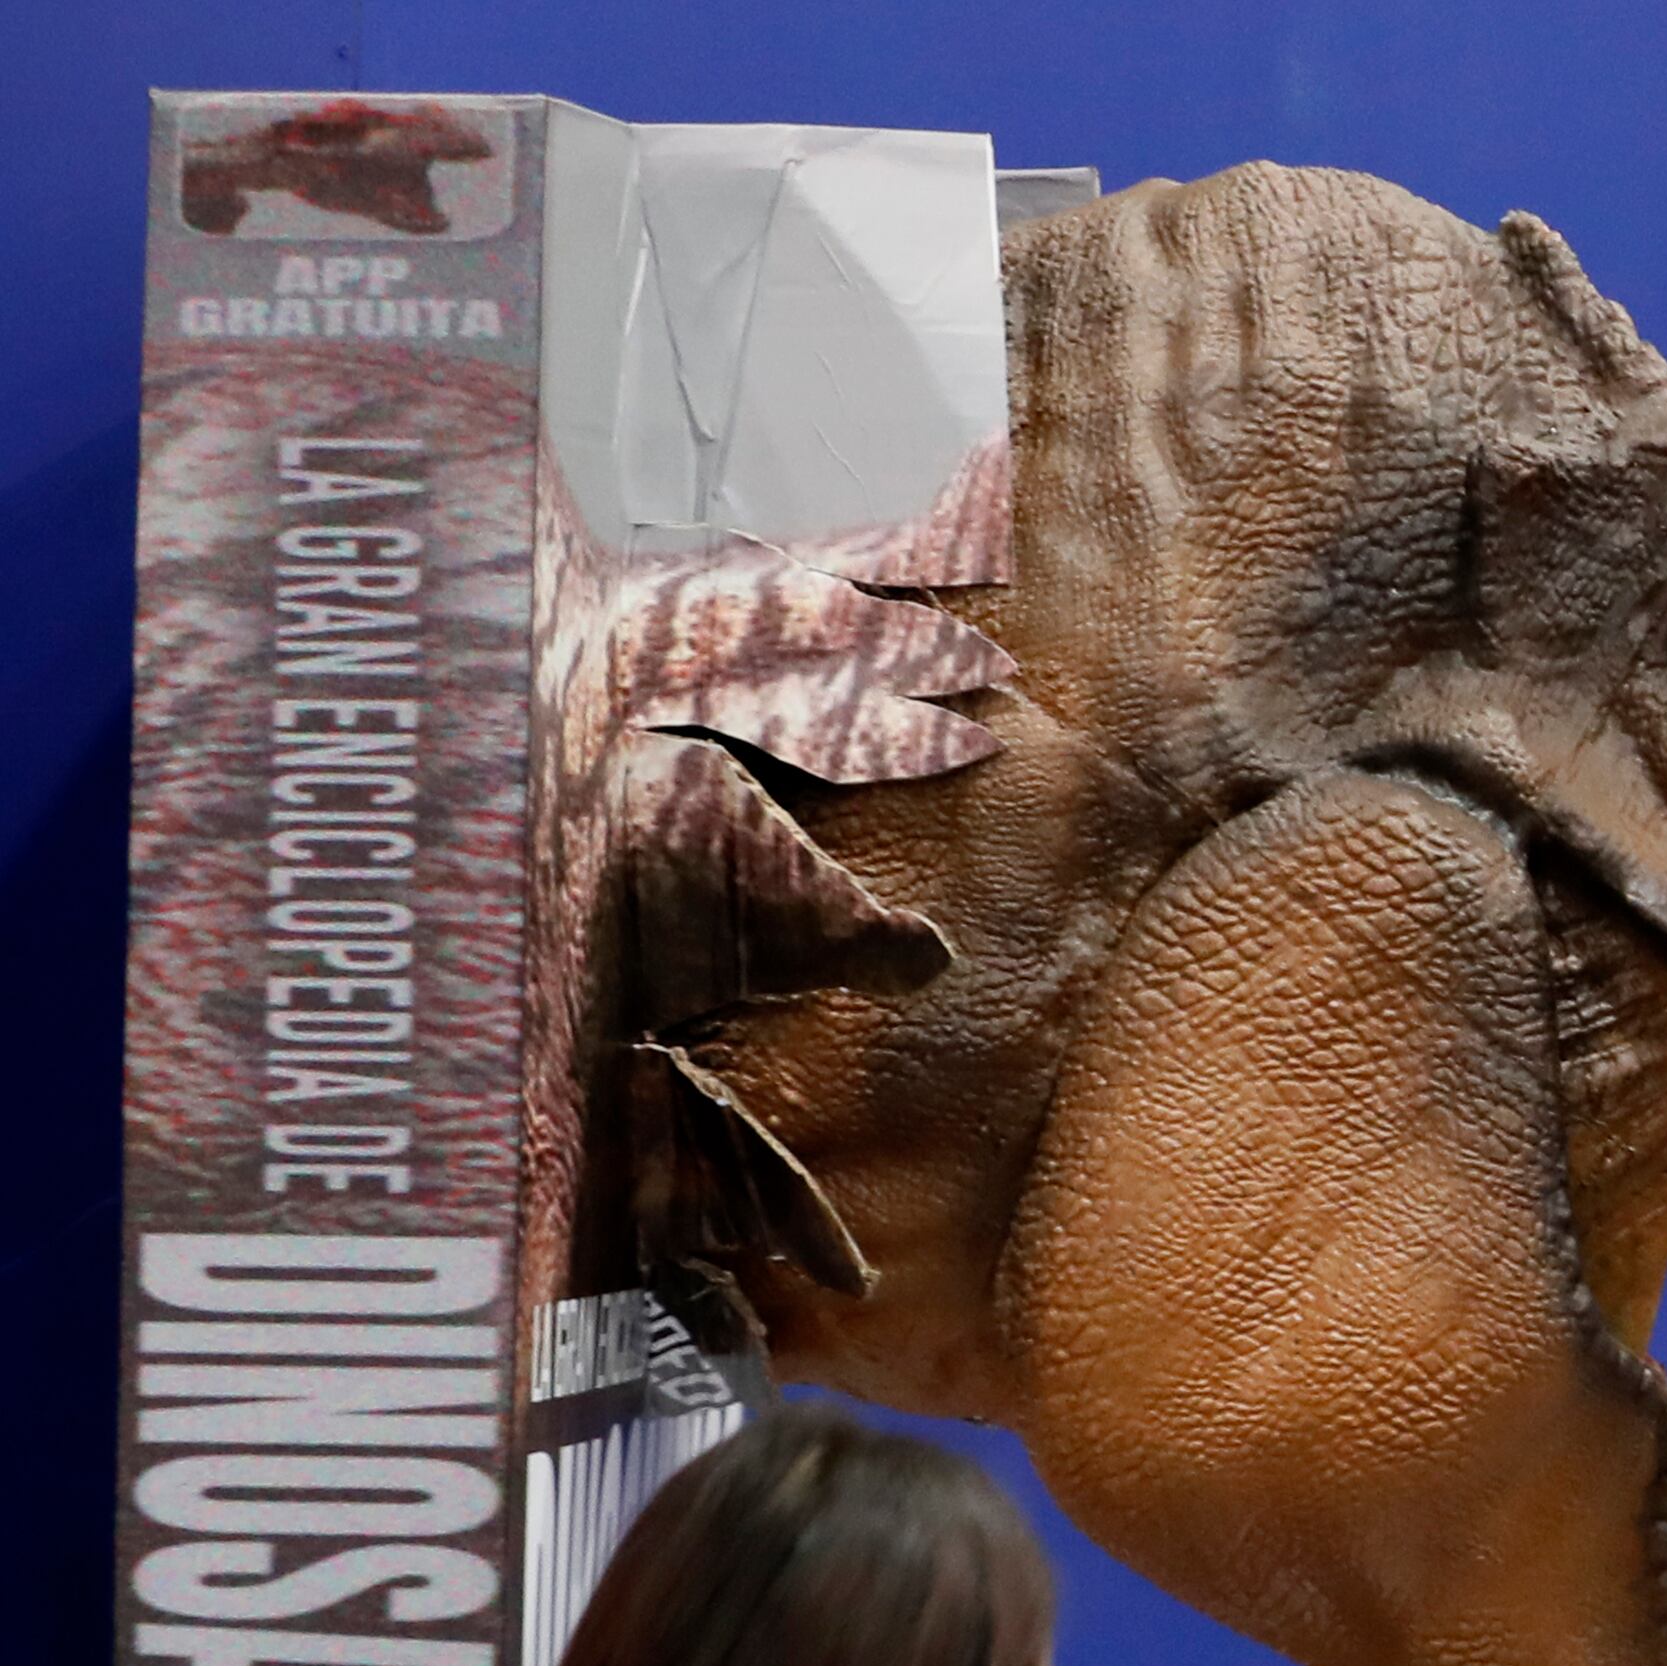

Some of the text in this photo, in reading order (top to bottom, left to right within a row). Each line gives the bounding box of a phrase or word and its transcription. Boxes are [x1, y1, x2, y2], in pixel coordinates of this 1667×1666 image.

[275, 256, 410, 296] APP
[180, 297, 502, 339] GRATUITA
[262, 438, 423, 1194] LA GRAN ENCICLOPEDIA DE
